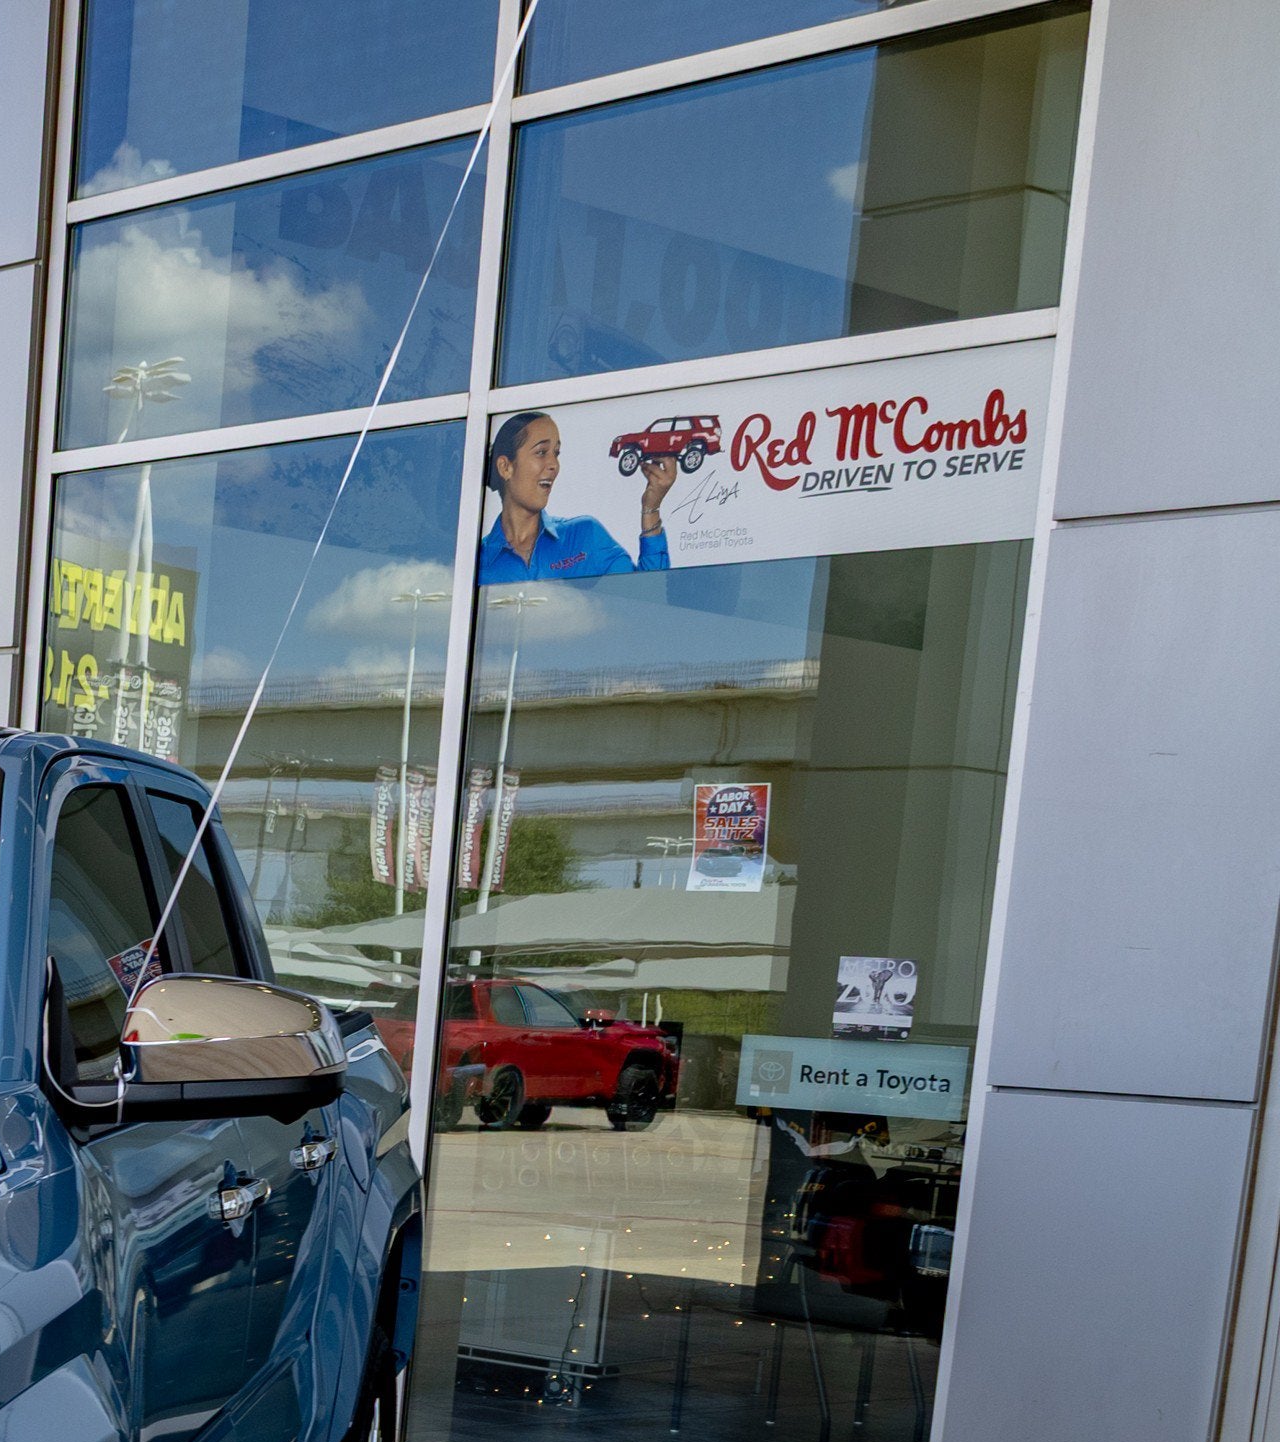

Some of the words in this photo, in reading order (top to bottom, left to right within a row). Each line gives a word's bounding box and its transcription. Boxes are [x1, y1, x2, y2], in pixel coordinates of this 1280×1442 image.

[730, 411, 816, 491] Red
[825, 389, 1027, 461] McCombs
[801, 463, 894, 492] DRIVEN
[903, 458, 937, 482] TO
[943, 449, 1026, 477] SERVE
[680, 530, 699, 541] Red
[701, 527, 748, 539] McCombs
[680, 539, 722, 552] Universal
[724, 537, 754, 548] Toyota
[716, 791, 750, 802] LABOR
[719, 801, 745, 814] DAY
[704, 816, 760, 829] SALES
[800, 1064, 850, 1086] Rent
[856, 1073, 868, 1087] a
[876, 1069, 951, 1094] Toyota
